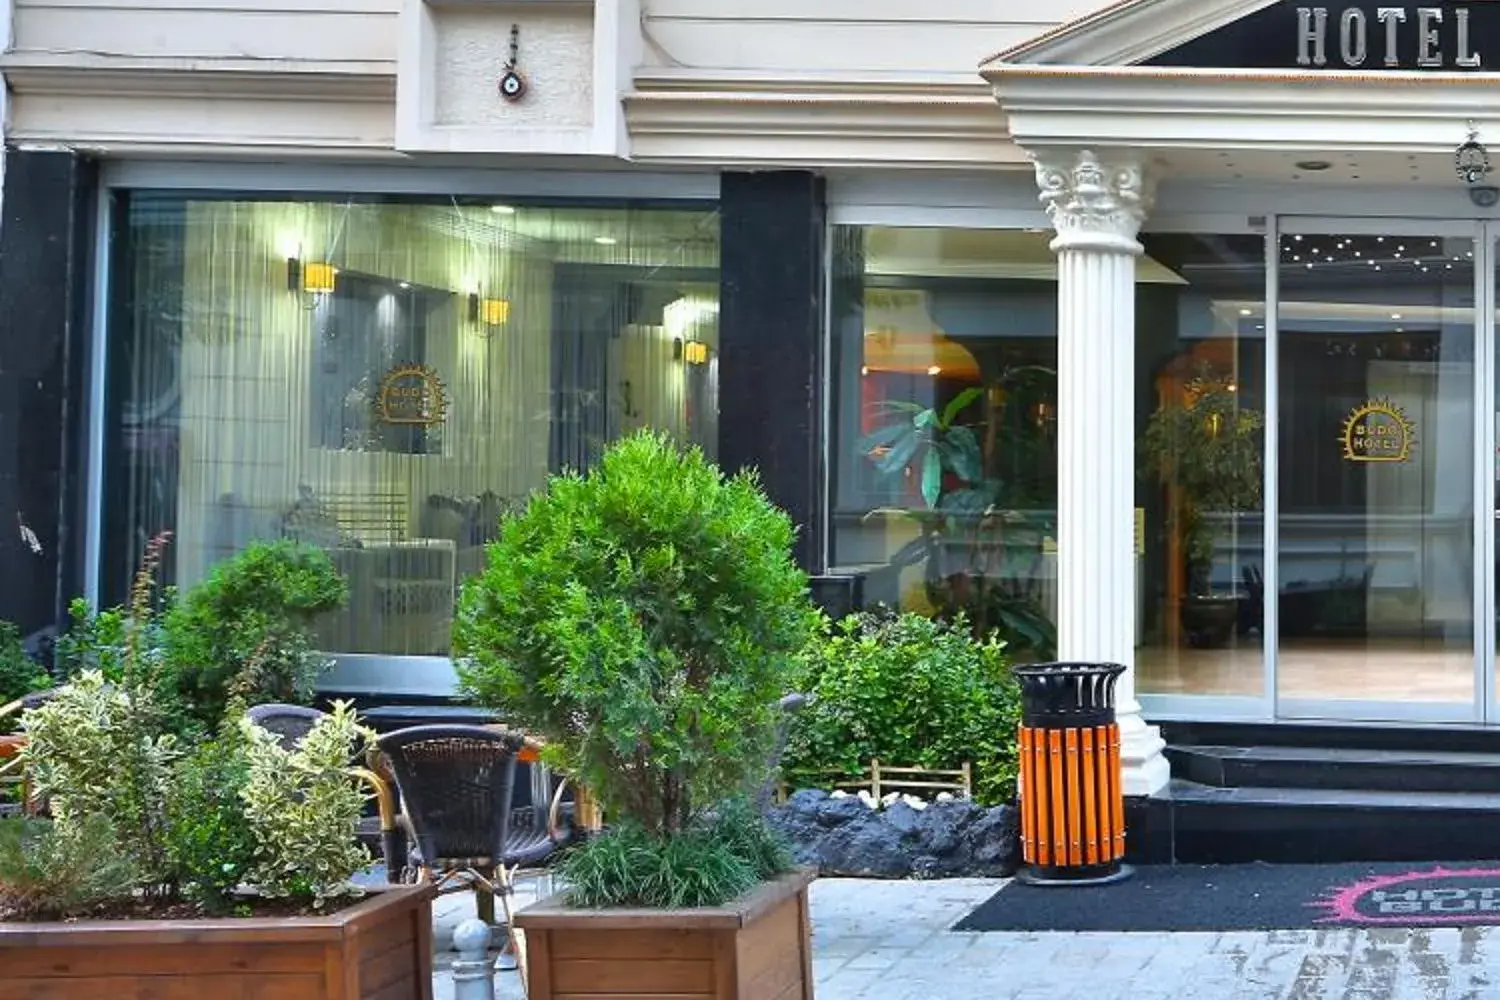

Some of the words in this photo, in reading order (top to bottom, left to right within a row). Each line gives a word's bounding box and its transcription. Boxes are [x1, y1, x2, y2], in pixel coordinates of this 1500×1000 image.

[1296, 7, 1481, 68] HOTEL
[1355, 425, 1398, 435] BUDO
[1353, 438, 1401, 449] HOTEL
